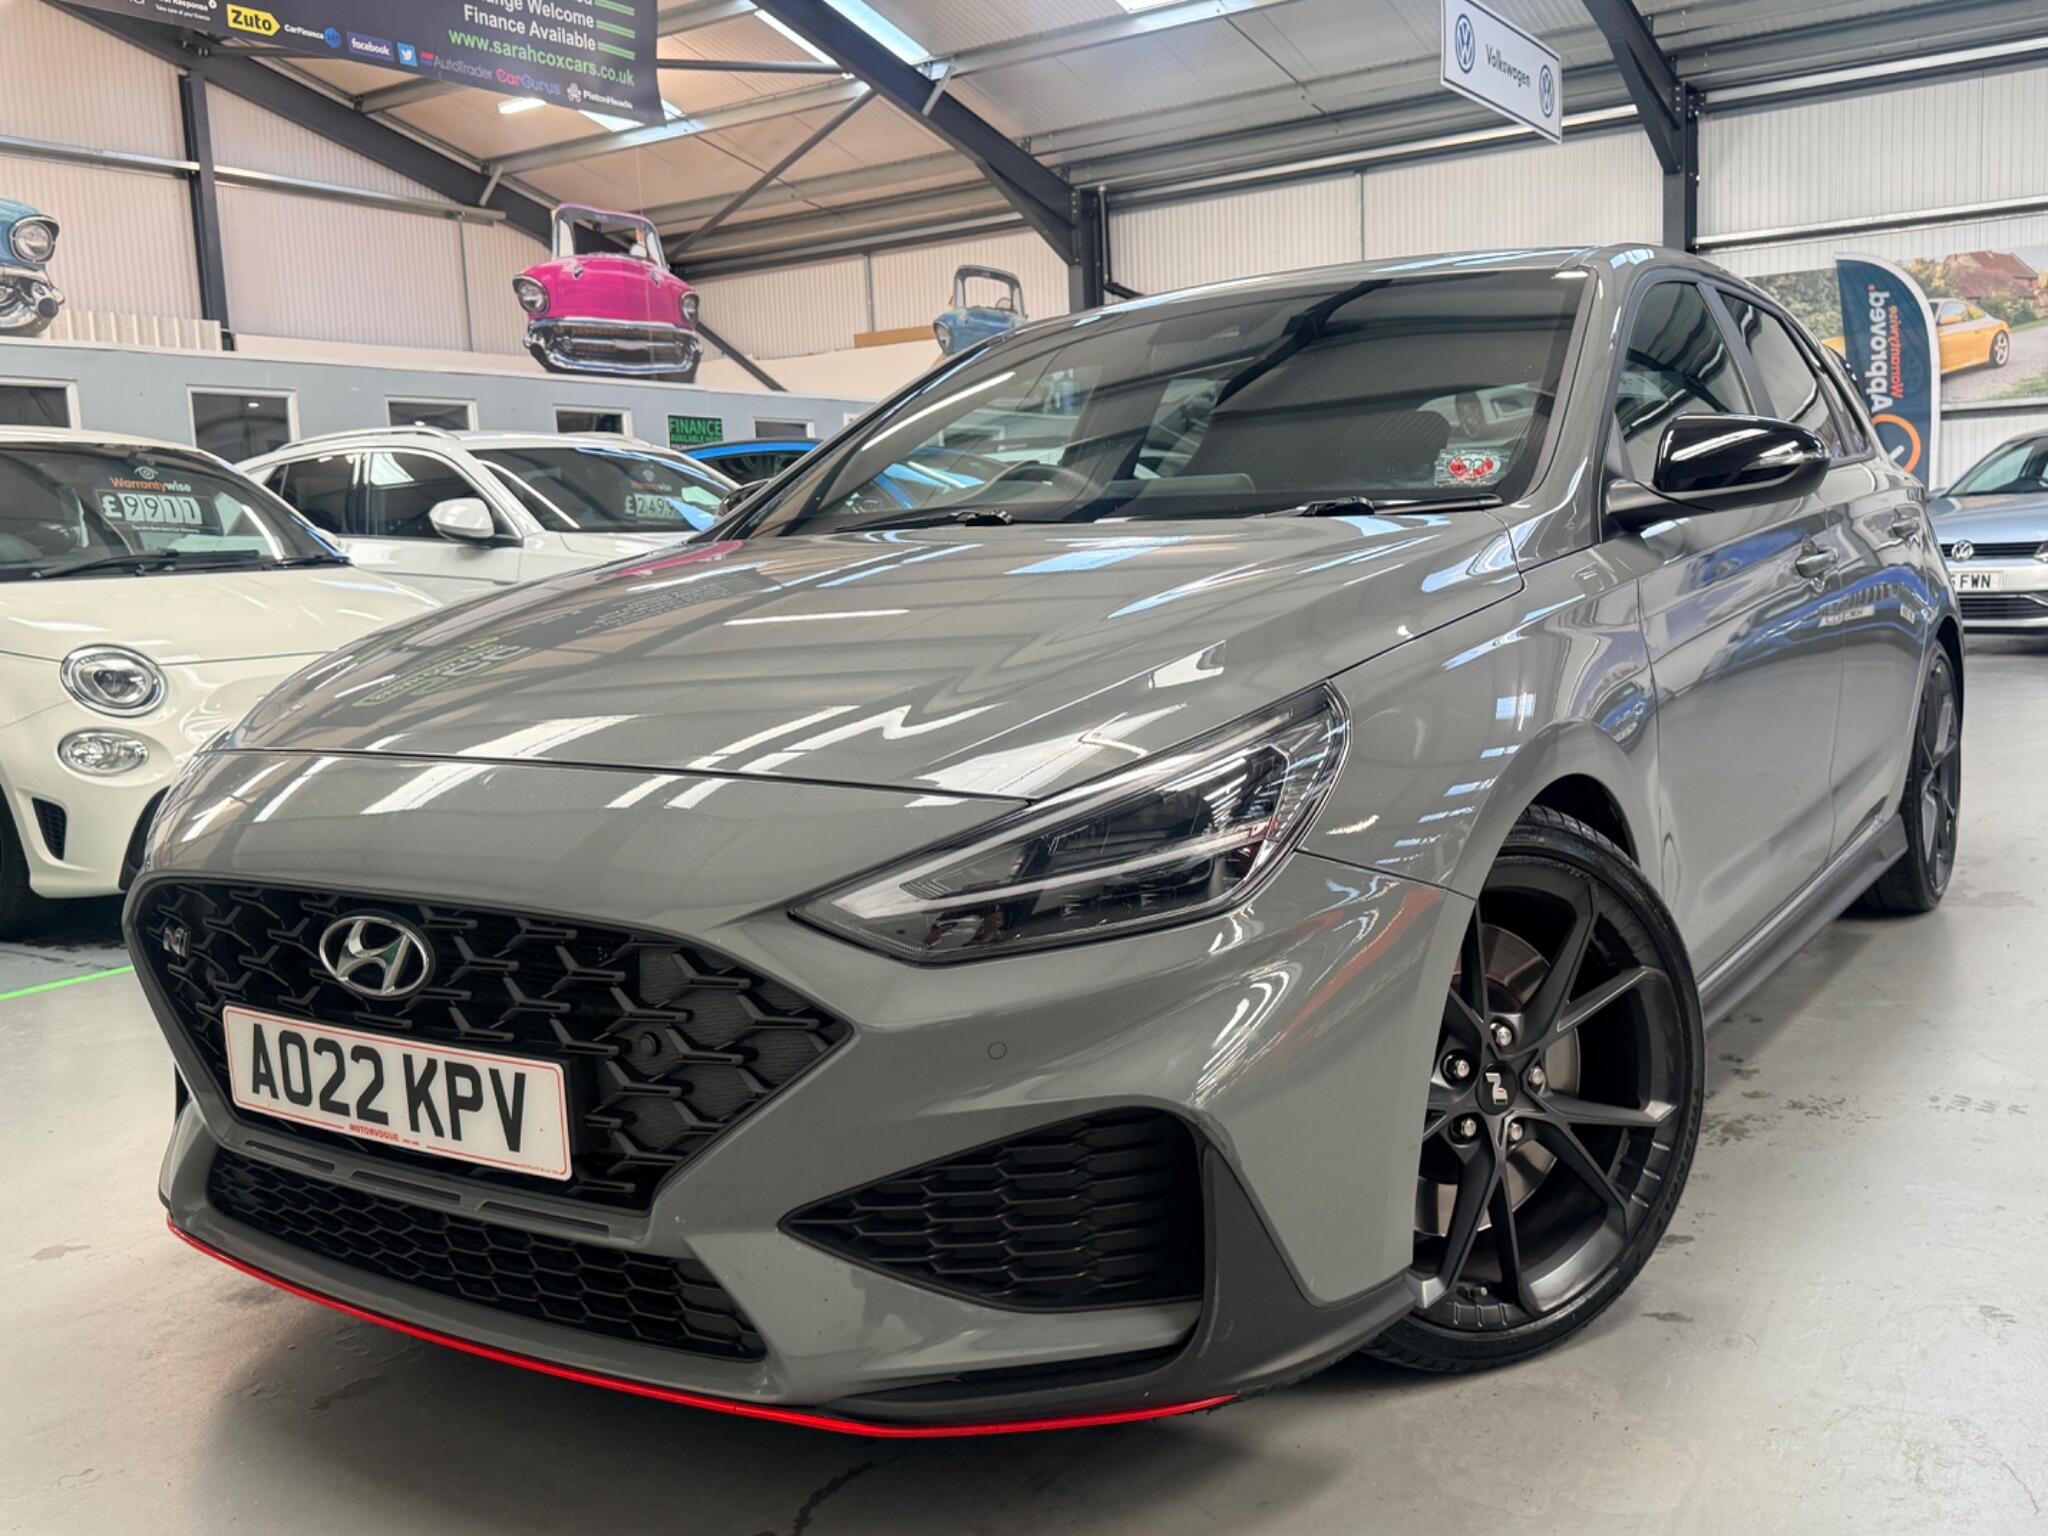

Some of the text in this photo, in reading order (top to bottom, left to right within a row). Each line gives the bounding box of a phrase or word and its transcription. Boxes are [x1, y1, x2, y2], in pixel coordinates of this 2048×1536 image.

[231, 9, 272, 32] Zuto
[527, 0, 595, 29] Welcome
[464, 3, 596, 51] Finance Available
[351, 37, 391, 56] facebook
[448, 29, 636, 87] www.sarahcoxcars.co.uk
[433, 56, 492, 80] AutoTrader
[1485, 43, 1531, 88] Volkswagen
[496, 67, 561, 96] CarGurus
[669, 417, 722, 436] FINANCE
[110, 476, 192, 493] Warrantywise
[1960, 574, 1992, 589] FWN
[402, 1052, 526, 1154] KPV
[348, 1123, 400, 1142] MOTORVOGUE
